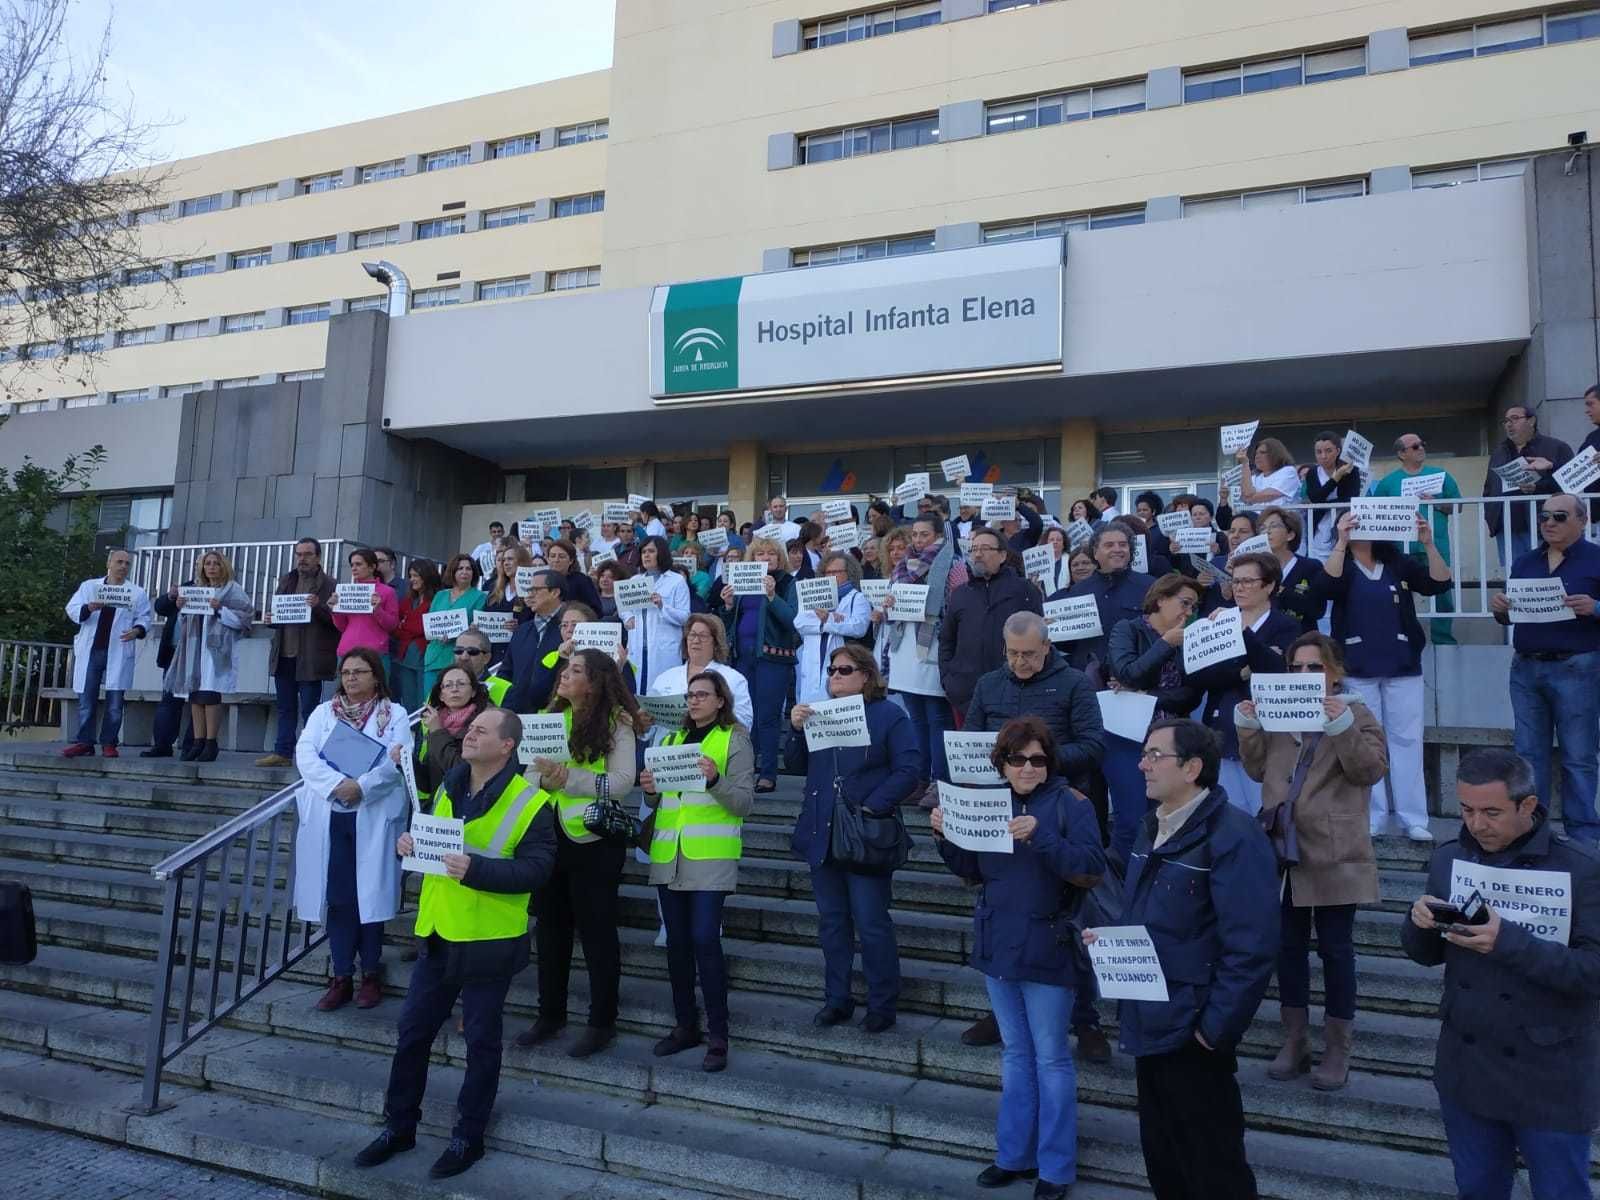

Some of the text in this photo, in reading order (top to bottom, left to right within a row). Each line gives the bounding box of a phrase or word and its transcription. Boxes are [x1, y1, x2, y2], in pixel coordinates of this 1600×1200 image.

[758, 294, 1034, 345] Hospital Infanta Elena
[673, 364, 688, 372] JUNTA
[803, 594, 832, 603] AUTOBUS
[1073, 602, 1095, 610] ENERO
[1061, 622, 1096, 632] CUANDO?
[1200, 628, 1233, 645] RELEVO
[1187, 639, 1236, 663] PA CUANDO?
[1289, 683, 1322, 691] ENERO
[1264, 697, 1323, 705] TRANSPORTE
[836, 704, 861, 714] ENERO
[1258, 710, 1321, 719] PA CUANDO?
[820, 715, 864, 727] TRANSPORTE
[825, 728, 862, 738] CUANDO?
[530, 745, 563, 754] CUANDO?
[662, 763, 701, 772] TRANSPORT
[968, 766, 996, 774] CUAN
[668, 774, 705, 783] CUANDO?
[959, 799, 970, 807] DE
[974, 800, 1008, 808] ENERO
[952, 811, 1009, 822] TRANSPORTE
[436, 827, 461, 836] ENERO
[945, 821, 1006, 838] PA CUANDO?
[416, 838, 461, 851] TRANSPORTE
[419, 851, 444, 862] CUAN
[1456, 875, 1565, 897] Y EL 1 DE ENERO
[1098, 939, 1108, 947] EL
[1116, 939, 1125, 947] DE
[1126, 939, 1151, 947] ENERO
[1094, 955, 1158, 967] ¿EL TRANSPORTE
[1101, 973, 1158, 983] PA CUANDO?
